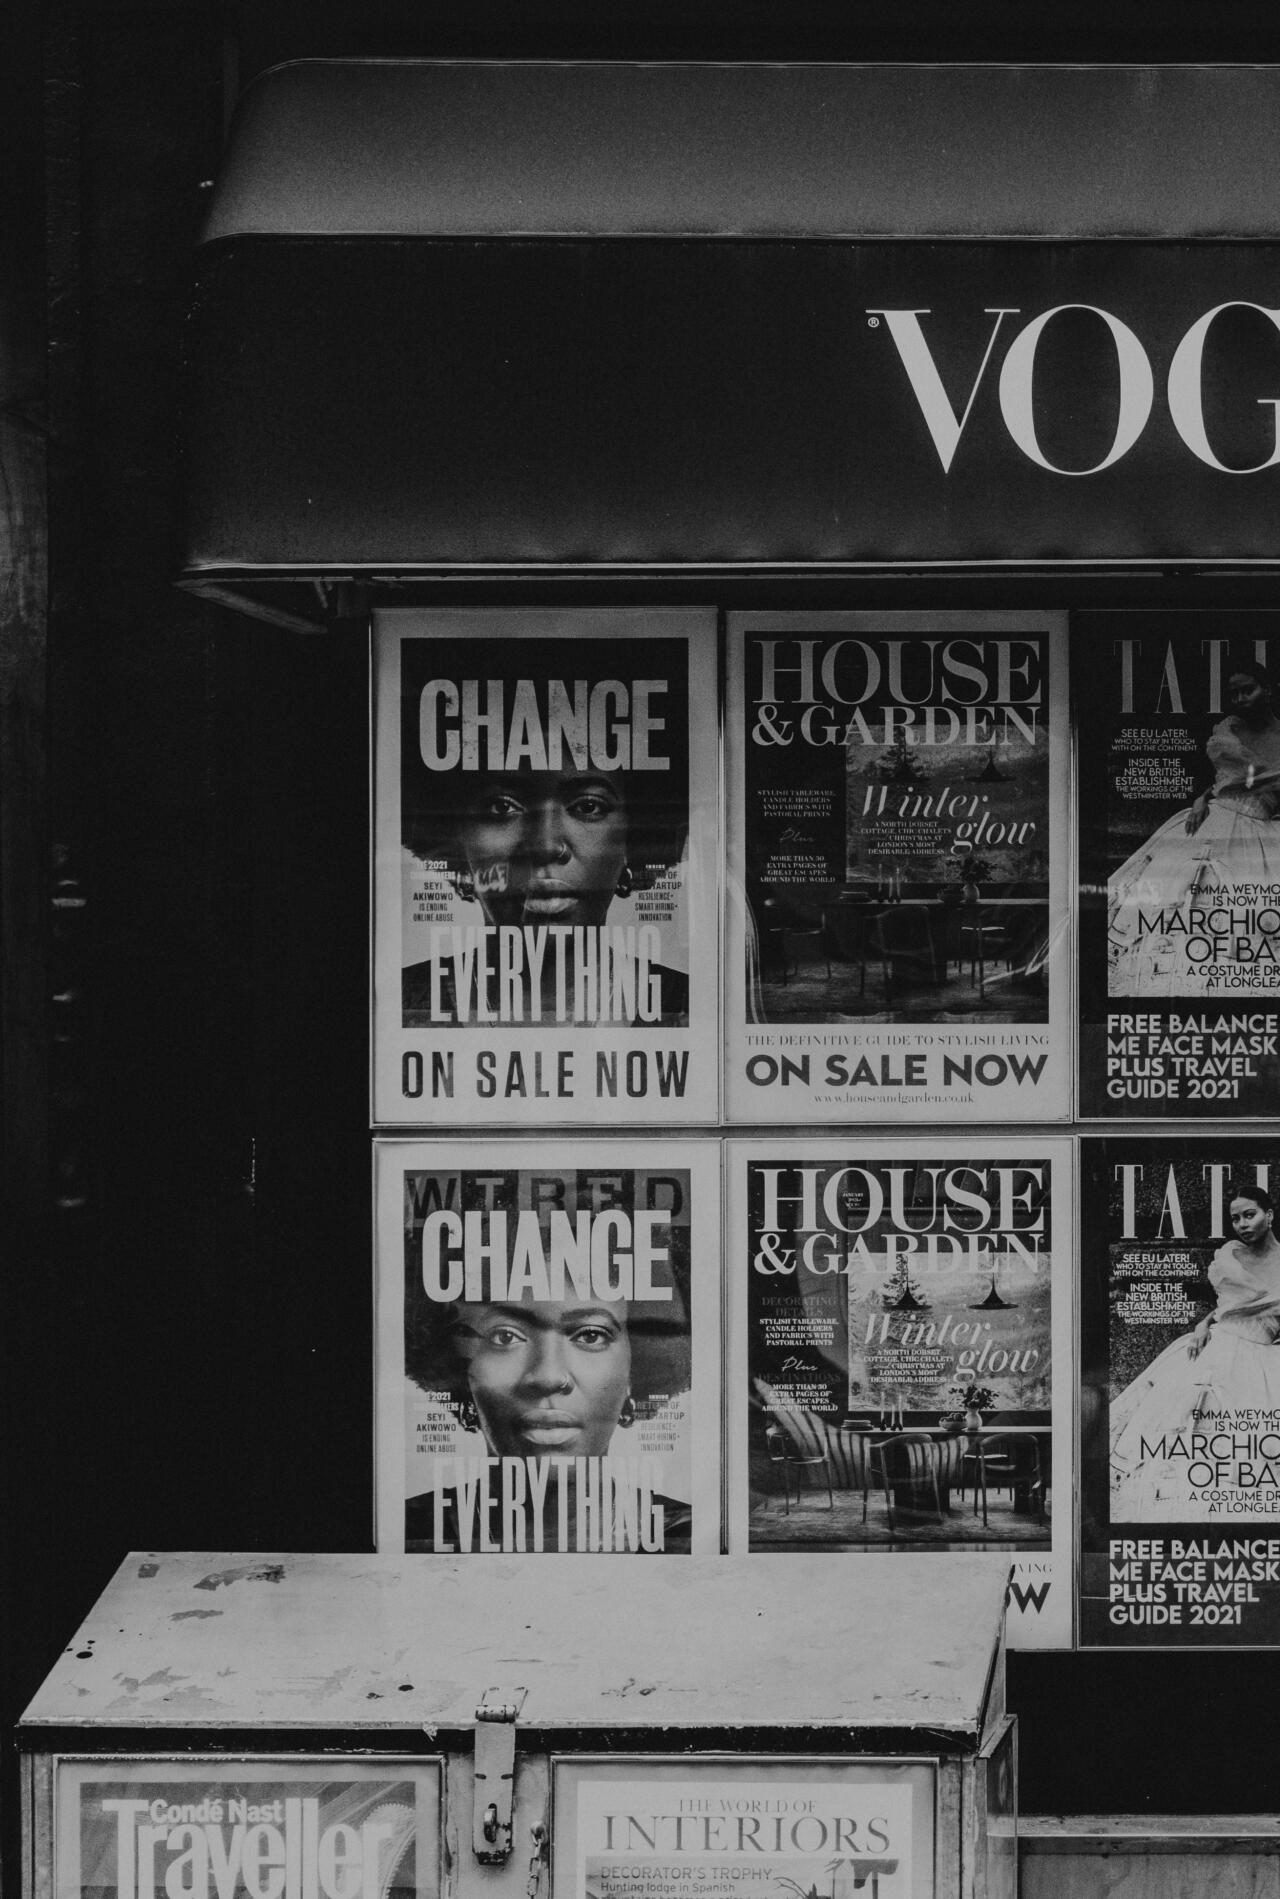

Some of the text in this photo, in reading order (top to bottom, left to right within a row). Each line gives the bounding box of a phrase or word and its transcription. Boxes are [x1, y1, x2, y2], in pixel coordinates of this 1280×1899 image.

[753, 639, 1042, 705] HOUSE
[419, 679, 671, 772] CHANGE
[751, 701, 1039, 747] & GARDEN
[862, 785, 989, 818] Winter
[950, 812, 1036, 855] glow
[423, 881, 443, 891] SEYI
[1190, 883, 1230, 895] EMMA
[413, 892, 454, 902] AKIWOWO
[1212, 896, 1224, 907] IS
[1226, 896, 1259, 907] NOW
[413, 913, 454, 922] ONLINE ABUSE
[1185, 936, 1229, 963] OF
[430, 925, 662, 1023] EVERYTHING
[1186, 965, 1196, 976] A
[1199, 965, 1261, 976] COSTUME
[1206, 977, 1222, 988] AT
[1107, 1014, 1278, 1034] FREE BALANCE
[746, 1035, 1050, 1046] THE DEFINITIVE GUIDE TO STYLISH LIVING
[1107, 1036, 1278, 1056] ME FACE MASK
[402, 1051, 690, 1098] ON SALE NOW
[745, 1054, 1048, 1086] ON SALE NOW
[1107, 1057, 1257, 1077] PLUS TRAVEL
[814, 1093, 974, 1104] www.houseandgarden.co.uk
[1106, 1079, 1239, 1099] GUIDE 2021
[406, 1177, 684, 1217] WIRED
[754, 1167, 1045, 1233] HOUSE
[421, 1209, 673, 1303] CHANGE
[753, 1233, 1044, 1275] & GARDEN
[1122, 1253, 1190, 1263] SEE EU LATER!
[1126, 1292, 1187, 1302] NEW BRITISH
[1130, 1283, 1183, 1293] INSIDE THE
[1117, 1301, 1196, 1311] ESTABLISHMENT
[863, 1313, 991, 1345] Winter
[780, 1356, 819, 1373] Plus
[953, 1339, 1039, 1382] glow
[1187, 1462, 1230, 1488] OF
[433, 1456, 665, 1553] EVERYTHING
[150, 1798, 284, 1825] Condé Nast
[677, 1798, 817, 1813] THE WORLD OF
[601, 1815, 891, 1854] INTERIORS
[102, 1798, 393, 1899] Traveller
[601, 1866, 773, 1880] DECORATOR'S TROPHY
[601, 1881, 735, 1894] Hunting lodge in Spanish
